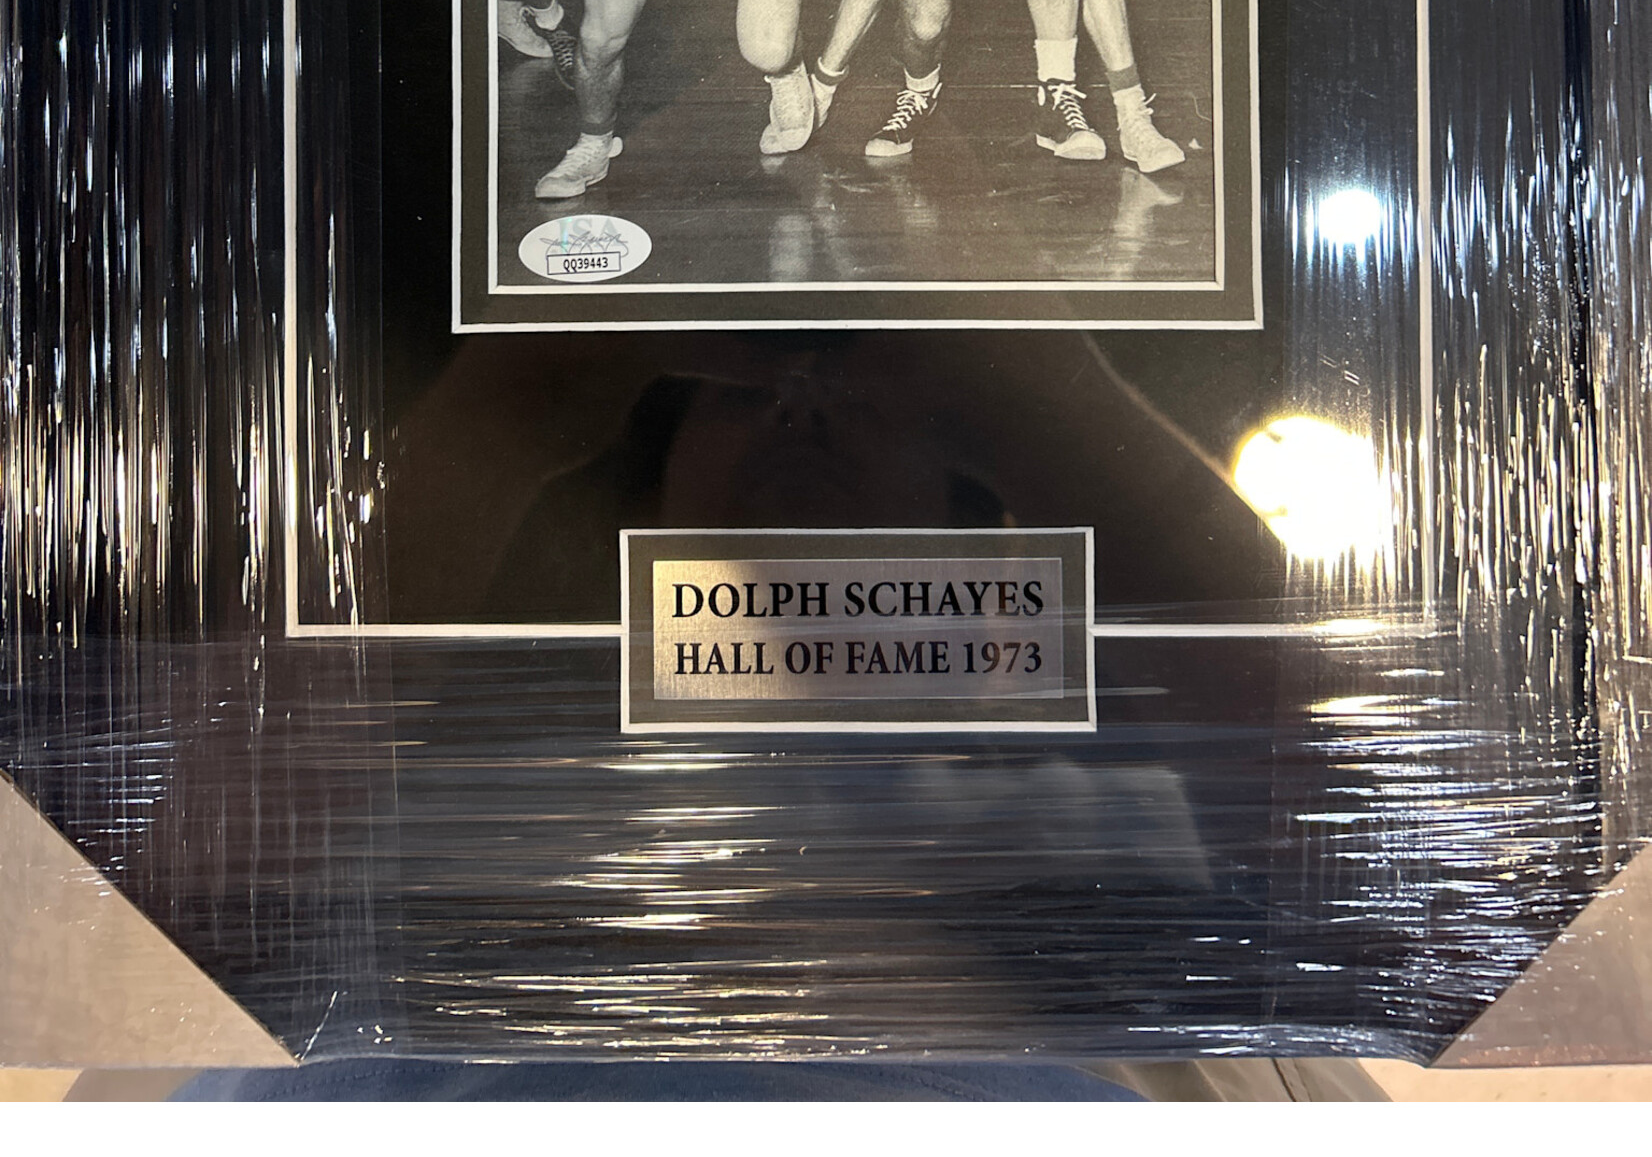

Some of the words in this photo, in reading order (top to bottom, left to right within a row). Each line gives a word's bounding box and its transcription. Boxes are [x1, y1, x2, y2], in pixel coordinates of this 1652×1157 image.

[562, 256, 609, 273] QQ39443
[671, 582, 830, 618] DOLPH
[844, 580, 1044, 617] SCHAYES
[674, 642, 775, 676] HALL
[784, 642, 834, 675] OF
[845, 641, 951, 675] FAME
[964, 641, 1042, 674] 1973
